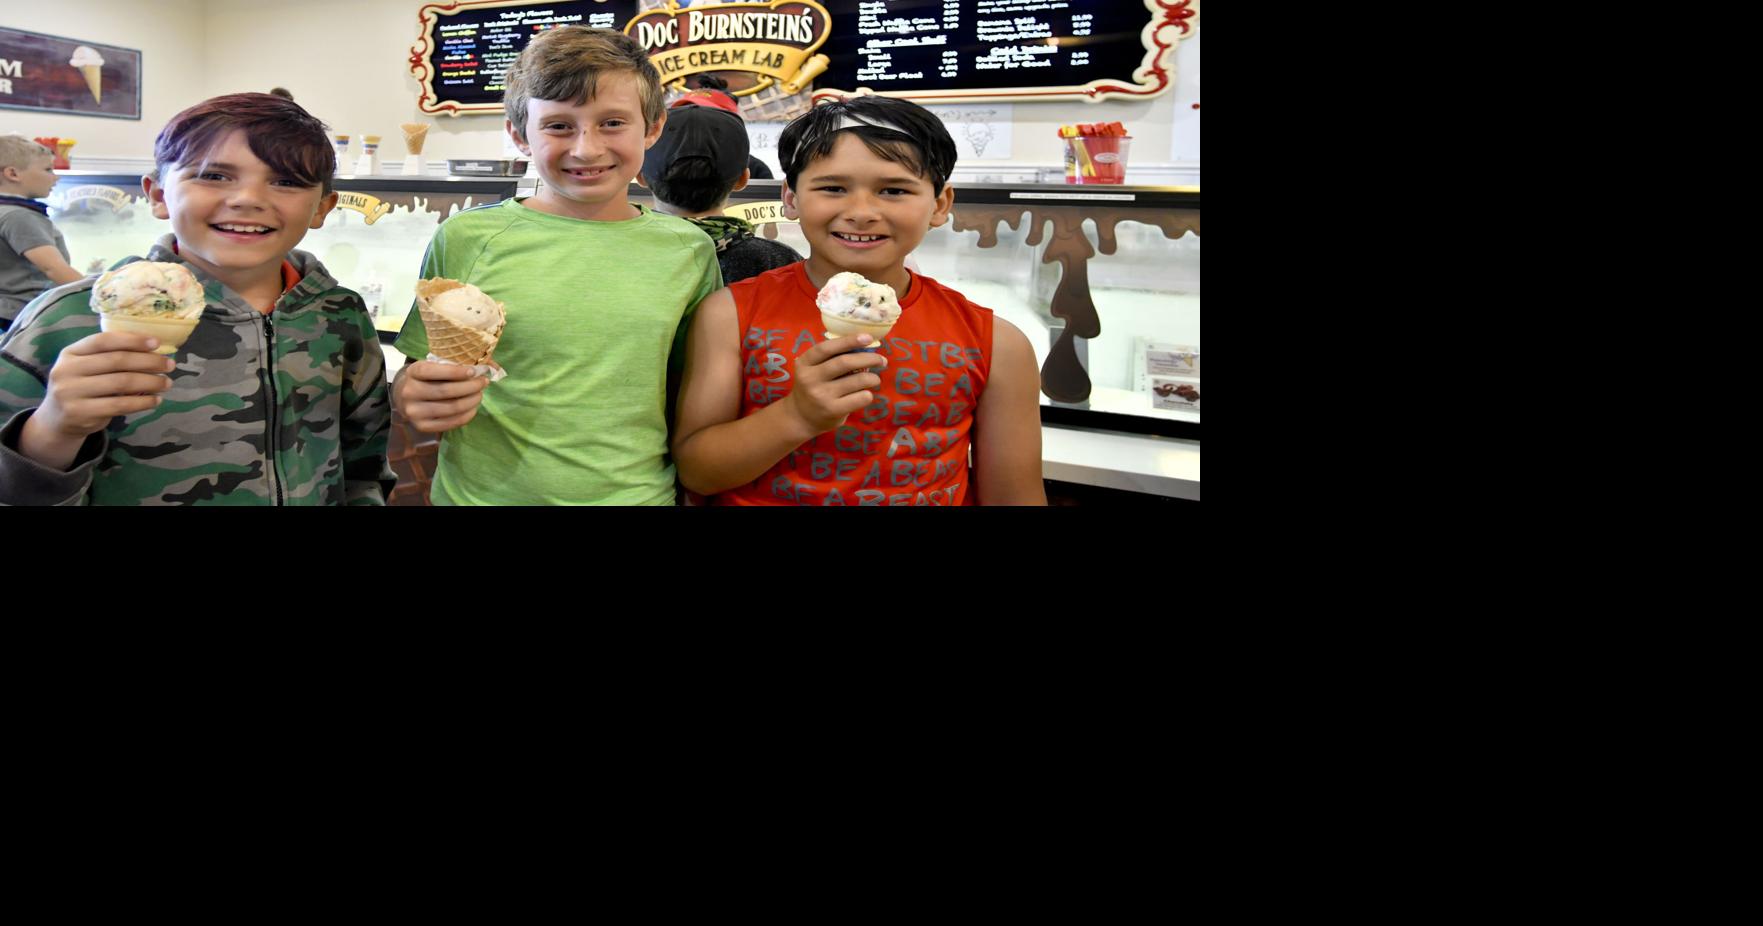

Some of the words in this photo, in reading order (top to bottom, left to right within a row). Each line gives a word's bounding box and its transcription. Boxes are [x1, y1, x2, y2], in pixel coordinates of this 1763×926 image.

[637, 18, 679, 50] DOC
[657, 54, 685, 75] ICE
[688, 50, 745, 68] CREAM
[752, 50, 785, 69] LAB
[339, 194, 368, 208] IGINALS
[744, 205, 776, 220] DOC'S
[896, 367, 944, 396] BE
[886, 427, 917, 458] A
[811, 452, 860, 480] BE
